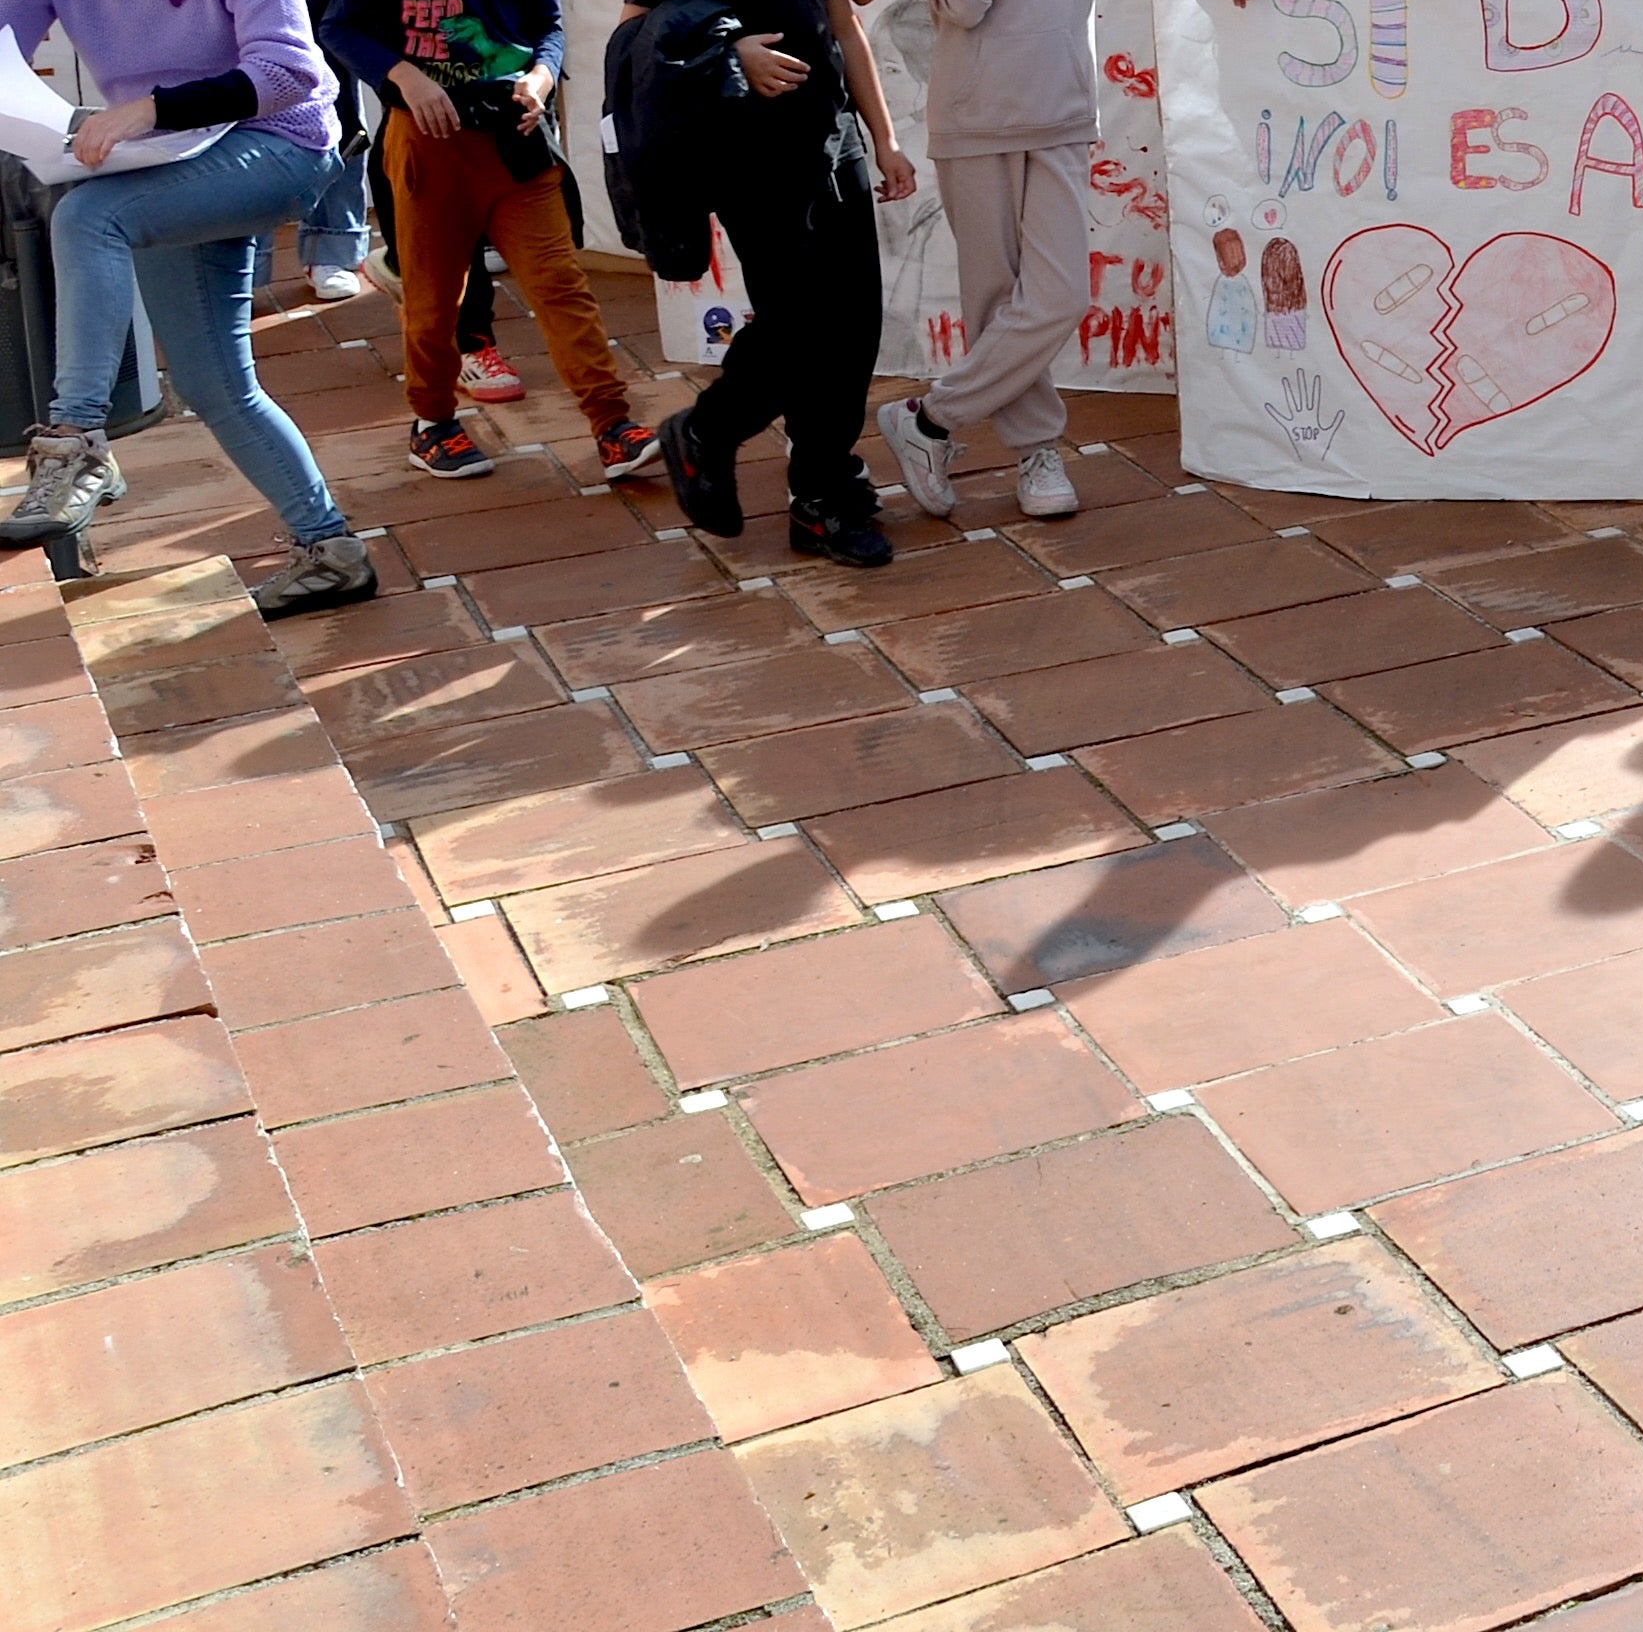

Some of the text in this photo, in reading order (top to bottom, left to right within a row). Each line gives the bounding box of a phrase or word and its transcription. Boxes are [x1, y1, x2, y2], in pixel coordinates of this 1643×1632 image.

[403, 28, 450, 60] THE
[1450, 107, 1550, 192] ES
[1291, 426, 1321, 442] STOP
